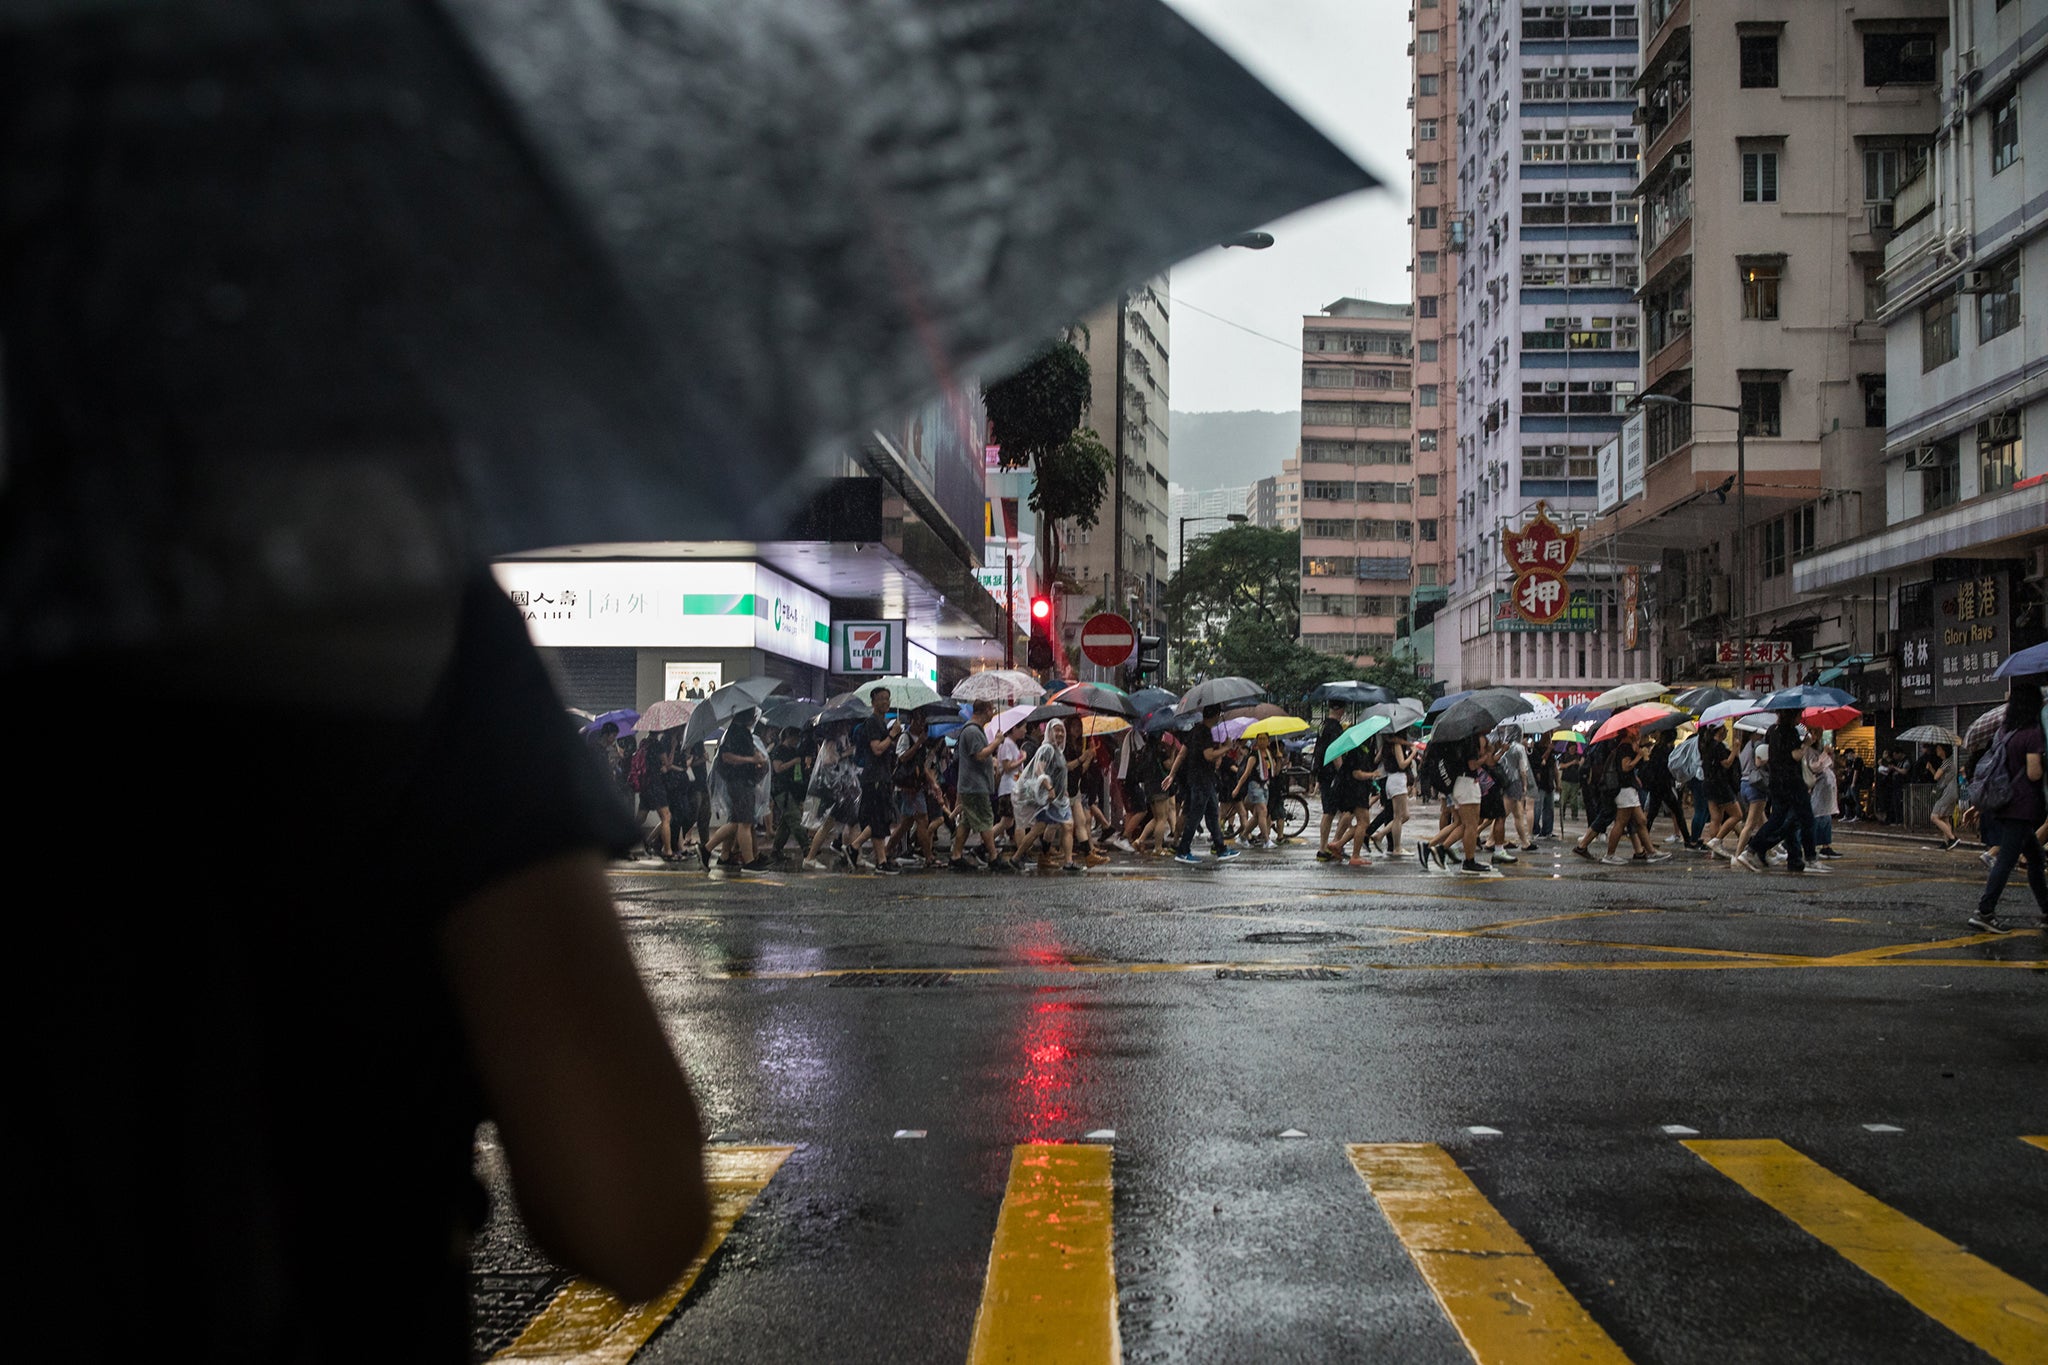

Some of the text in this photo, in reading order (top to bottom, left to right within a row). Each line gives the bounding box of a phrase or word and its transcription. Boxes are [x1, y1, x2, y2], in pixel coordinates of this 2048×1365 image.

[1519, 575, 1561, 616] 押
[854, 631, 881, 669] 7
[1944, 624, 1993, 646] Glory Rays
[1904, 638, 1928, 668] 格林
